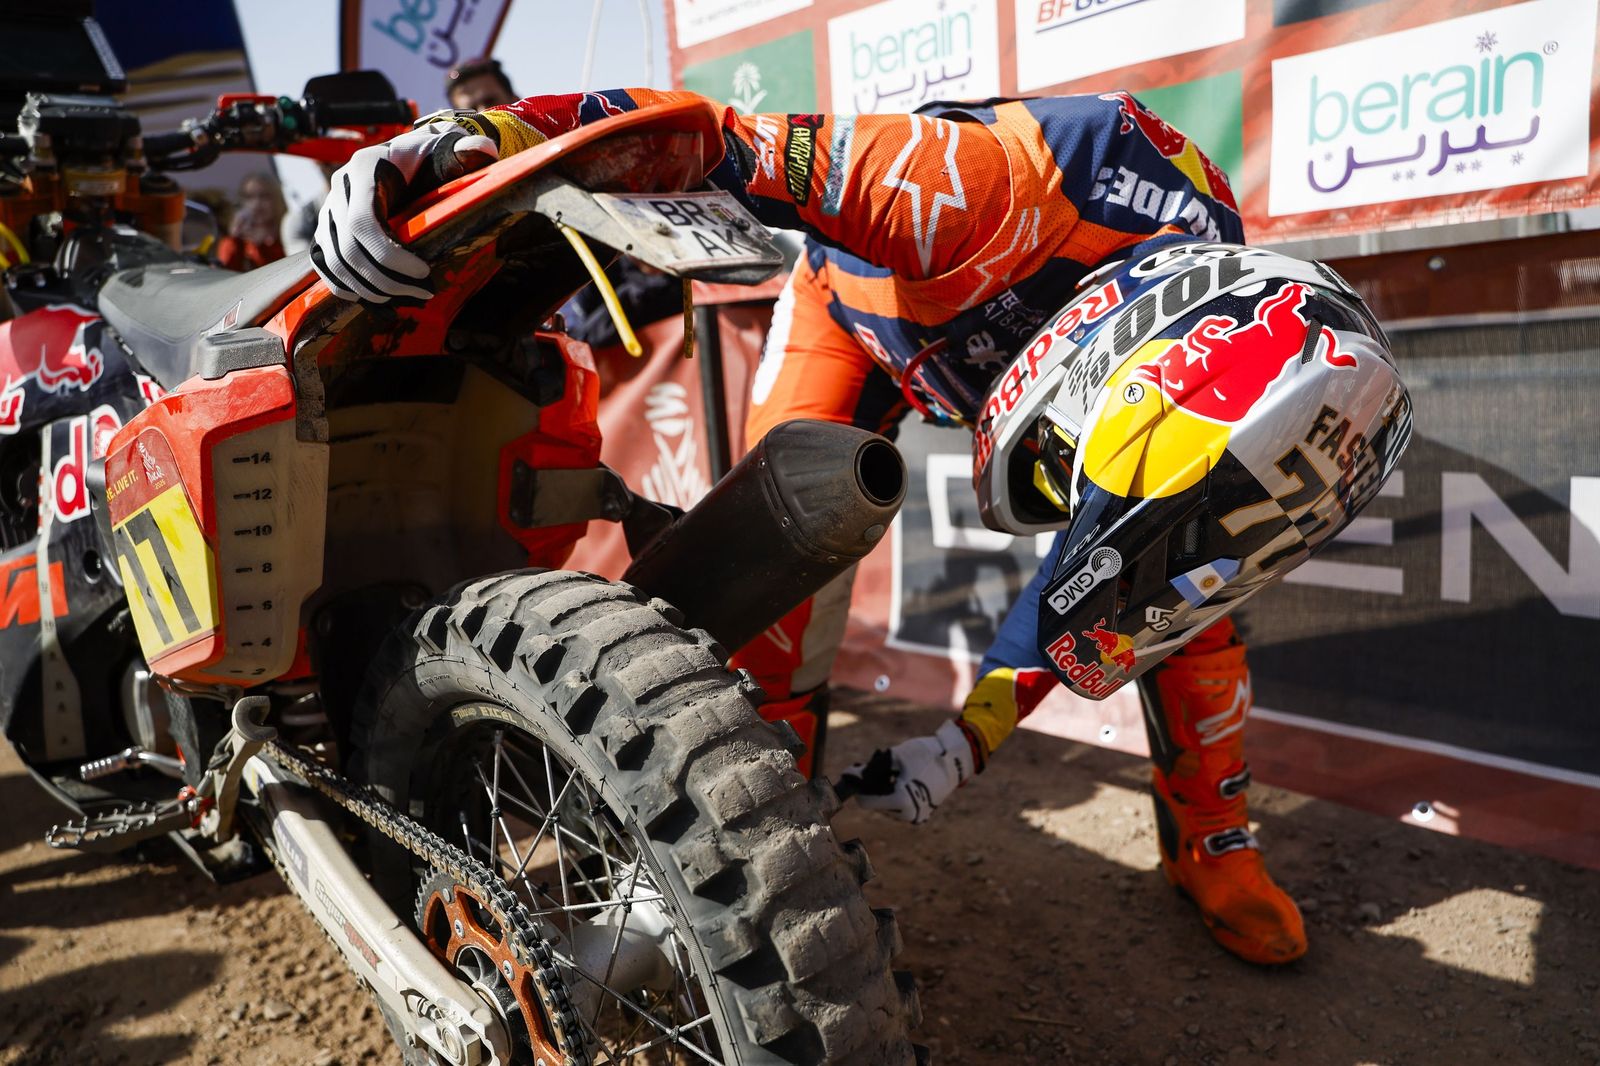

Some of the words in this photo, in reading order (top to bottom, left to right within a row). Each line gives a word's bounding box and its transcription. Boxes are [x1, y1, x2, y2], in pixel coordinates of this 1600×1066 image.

[849, 1, 972, 82] berain
[1307, 31, 1544, 146] berain
[1307, 114, 1541, 193] بيرين
[648, 200, 718, 226] BR
[251, 451, 272, 464] 14
[113, 474, 130, 496] LIVE
[252, 488, 272, 500] 12
[253, 524, 272, 536] 10
[262, 562, 272, 573] 8
[1053, 572, 1095, 610] GMC
[478, 705, 518, 724] EXCEL
